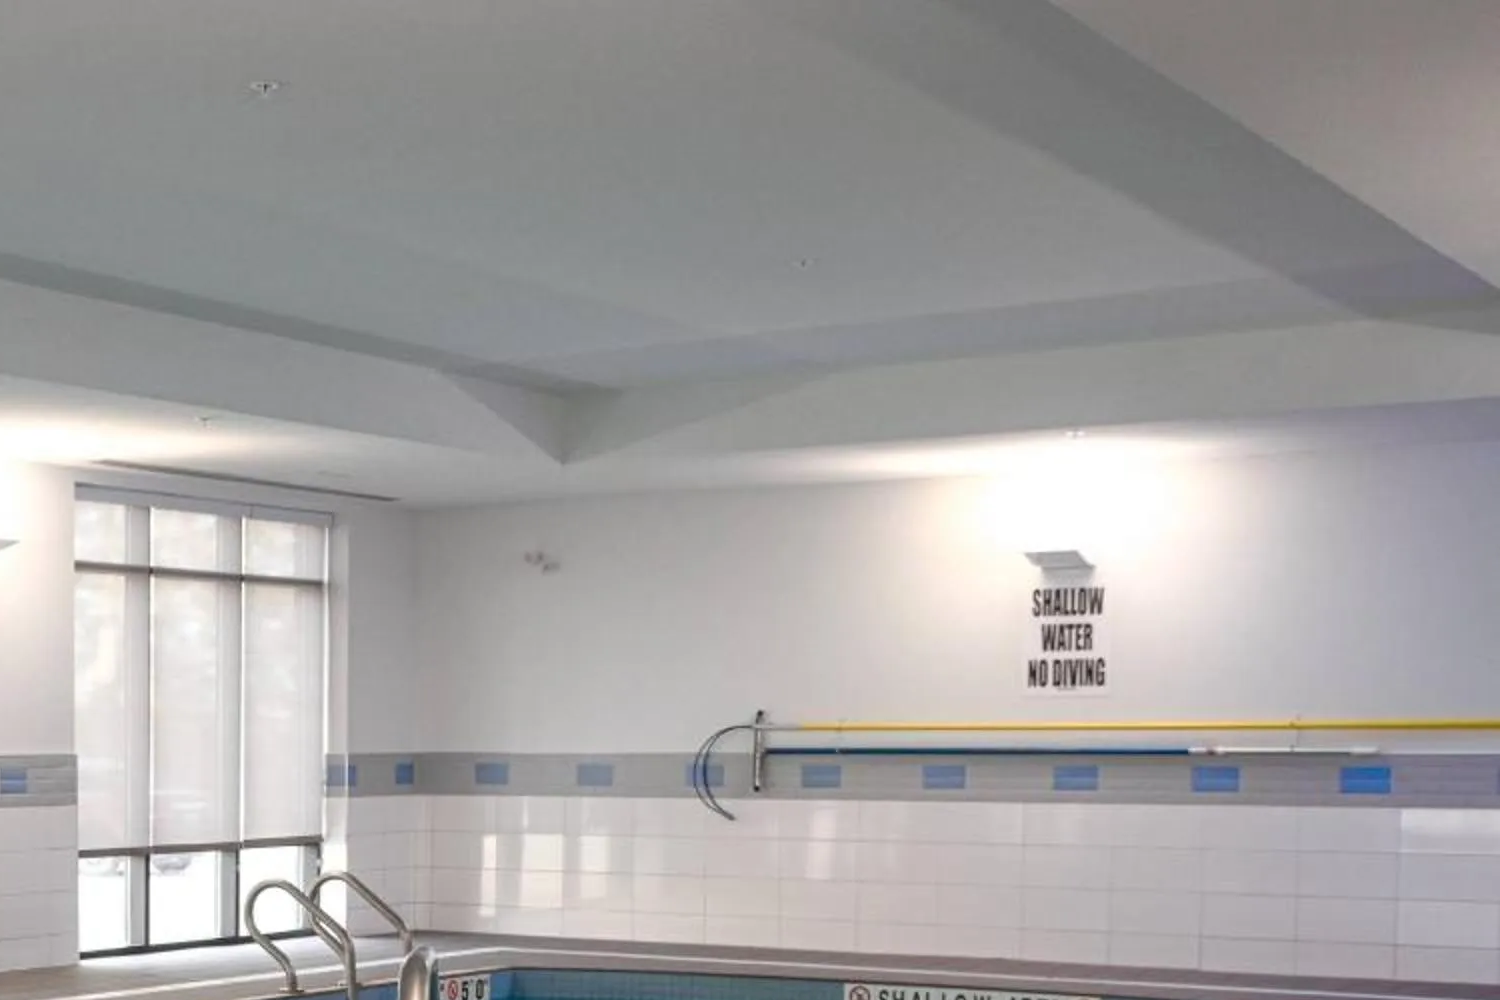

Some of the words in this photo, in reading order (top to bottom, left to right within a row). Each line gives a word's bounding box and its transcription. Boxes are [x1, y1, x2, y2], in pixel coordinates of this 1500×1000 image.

[1032, 587, 1105, 617] SHALLOW
[1041, 623, 1093, 651] WATER
[1027, 659, 1049, 688] NO
[1052, 657, 1106, 687] DIVING
